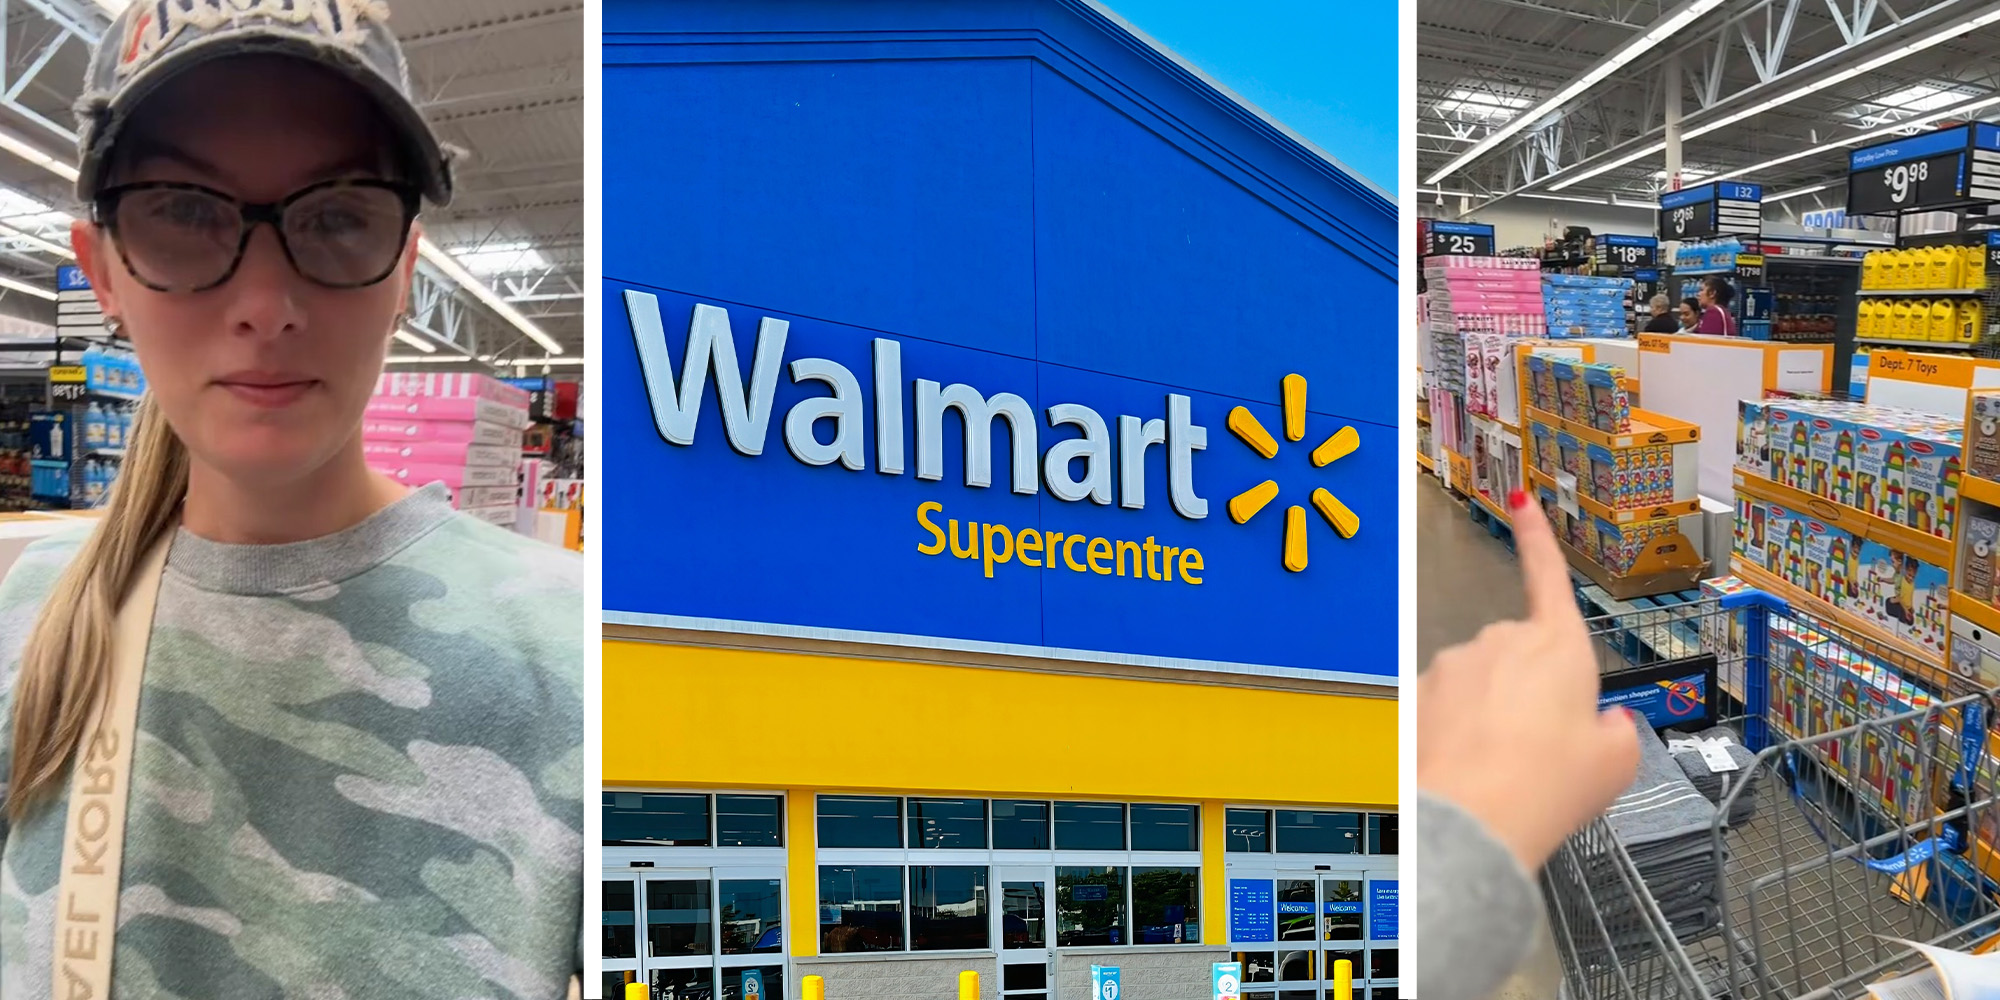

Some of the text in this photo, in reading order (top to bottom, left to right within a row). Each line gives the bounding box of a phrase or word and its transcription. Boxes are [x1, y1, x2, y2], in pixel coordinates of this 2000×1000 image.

[1853, 155, 1874, 164] Everyday
[1880, 356, 1938, 376] Dept. 7 Toys
[624, 289, 1208, 519] Walmart
[1857, 454, 1881, 465] Wooden
[1860, 461, 1878, 472] Blocks
[1906, 468, 1937, 481] Wooden
[1911, 476, 1933, 490] Blocks
[917, 501, 1205, 585] Supercentre
[1629, 688, 1660, 699] shoppers
[1281, 903, 1357, 912] Welcome Welcome
